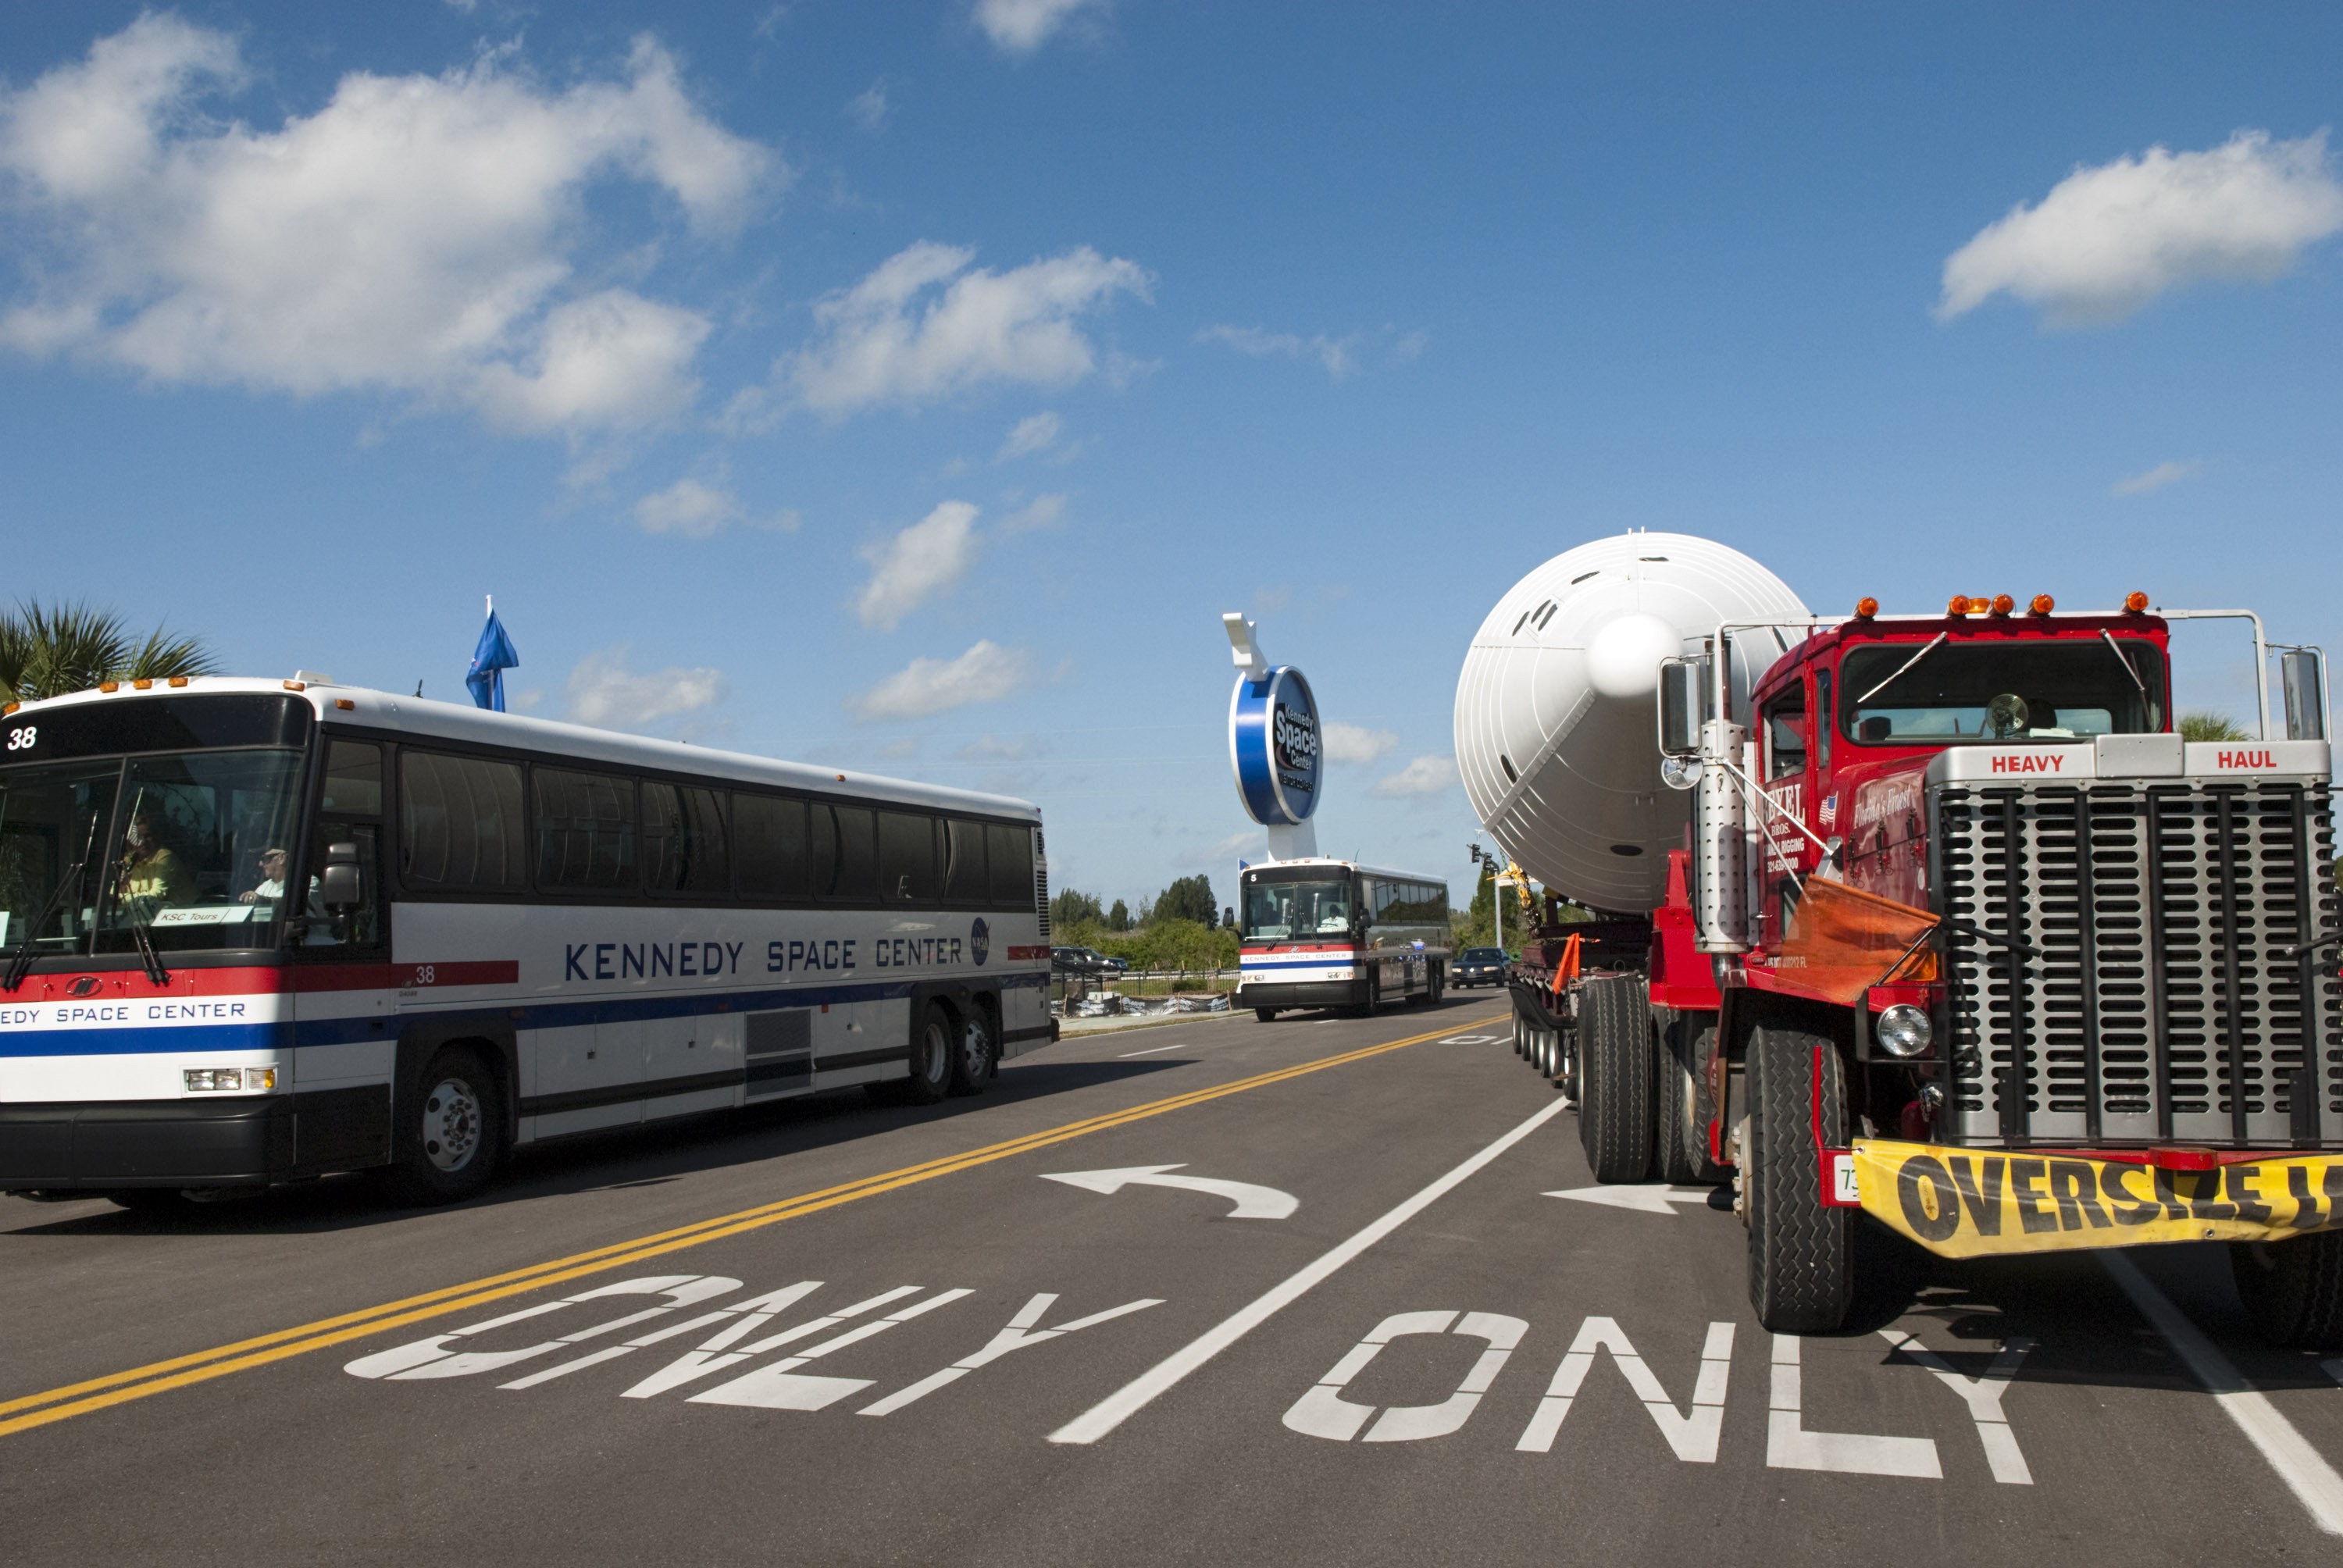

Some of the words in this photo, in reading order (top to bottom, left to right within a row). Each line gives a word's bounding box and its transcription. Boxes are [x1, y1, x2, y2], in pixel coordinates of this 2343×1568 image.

[1286, 703, 1314, 732] Kennedy
[8, 726, 37, 750] 38
[1276, 710, 1317, 756] Space
[1291, 750, 1312, 771] Center
[1992, 755, 2064, 772] HEAVY
[2218, 750, 2277, 768] HAUL
[1764, 783, 1805, 825] EYEL
[1886, 783, 1911, 815] Finest
[1771, 822, 1791, 836] BROS.
[1781, 837, 1805, 854] RIGGING
[565, 942, 744, 982] KENNEDY
[767, 940, 856, 973] SPACE
[876, 938, 961, 968] CENTER
[416, 966, 434, 984] 38
[0, 1010, 40, 1024] EDY
[56, 1007, 129, 1022] SPACE
[148, 1003, 245, 1019] CENTER
[1897, 1155, 2272, 1242] OVERSIZE
[344, 1275, 1167, 1417] ONLY
[1282, 1310, 2034, 1485] ONLY
